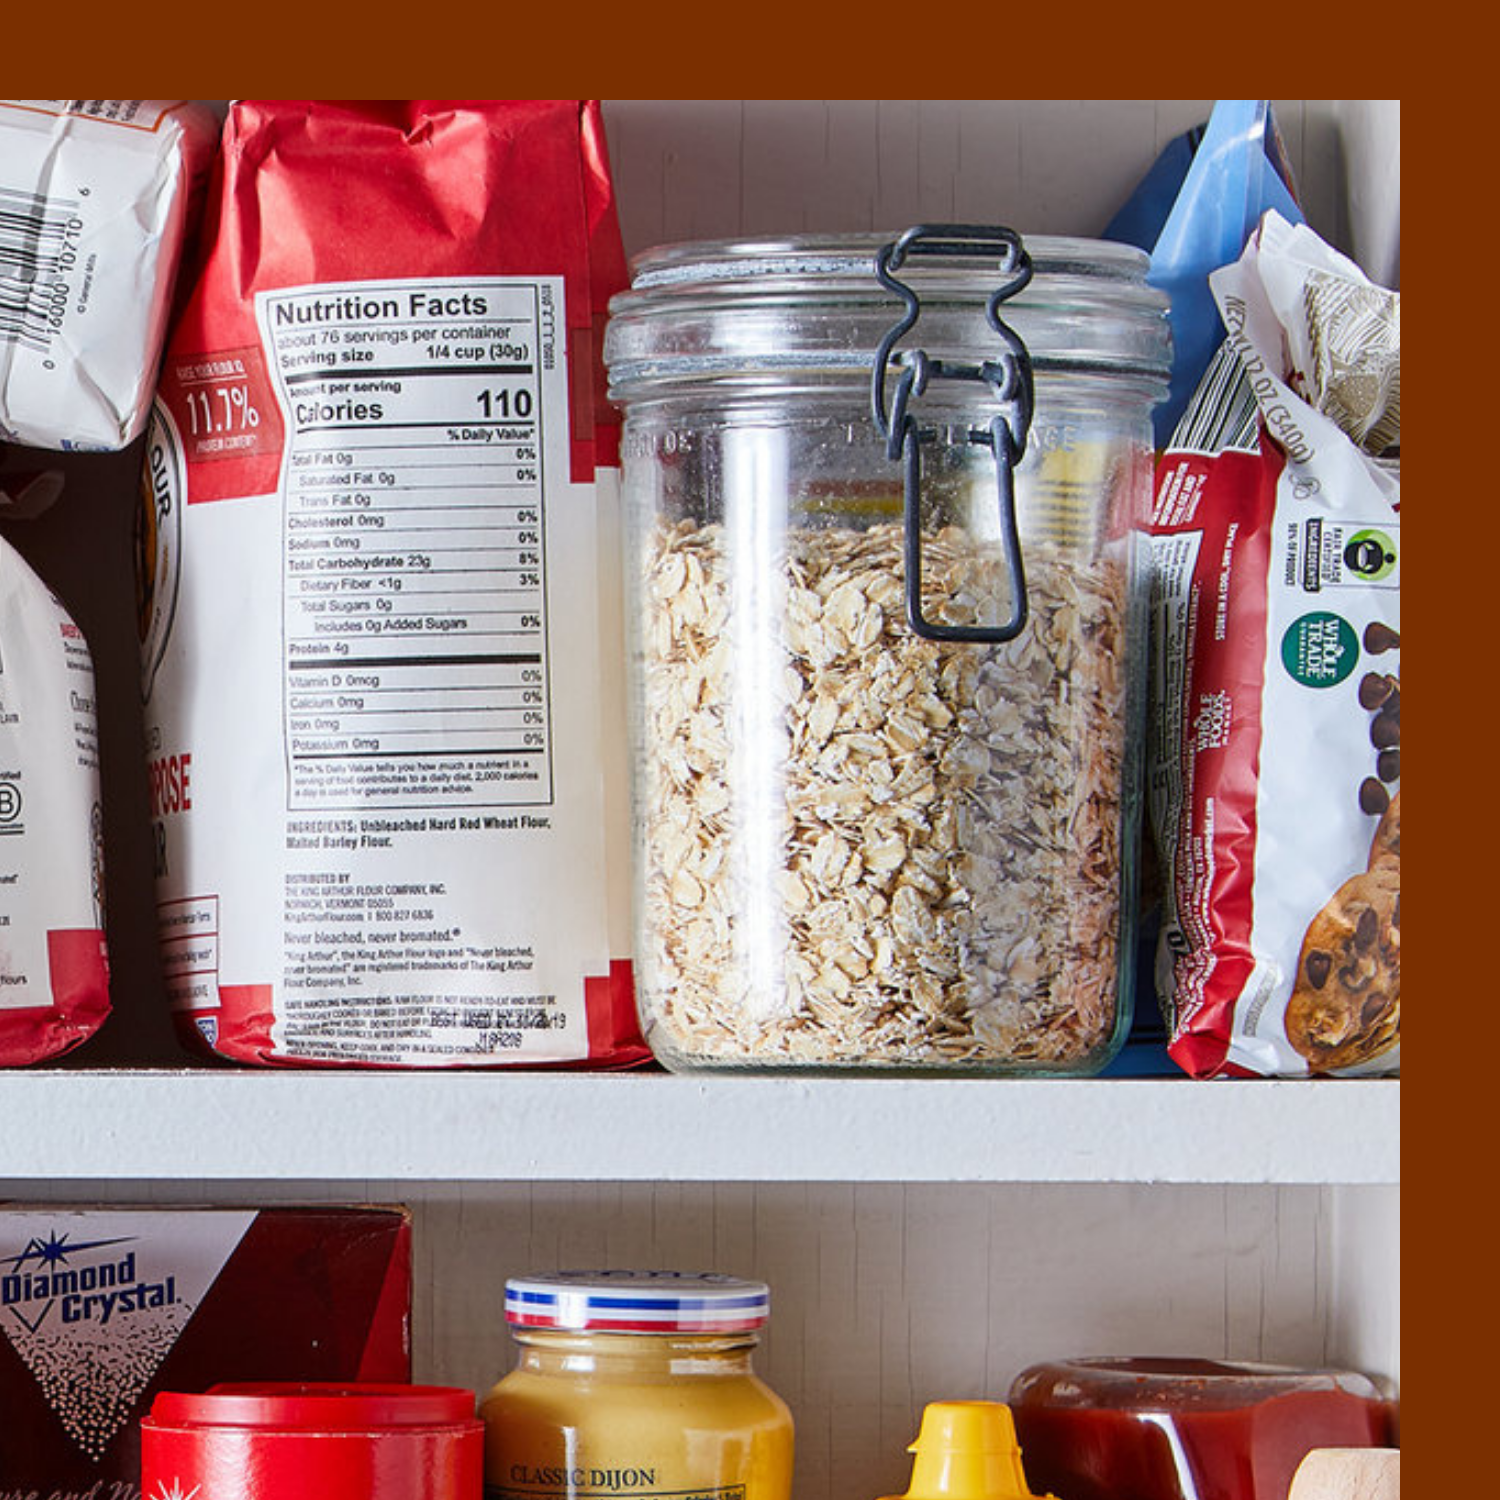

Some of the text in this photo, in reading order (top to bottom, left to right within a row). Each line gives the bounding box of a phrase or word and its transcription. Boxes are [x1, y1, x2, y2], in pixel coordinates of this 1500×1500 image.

[276, 293, 488, 325] Nutrition Facts
[344, 327, 408, 344] servings
[412, 329, 438, 343] per
[442, 326, 511, 340] container
[281, 349, 343, 368] Serving
[348, 348, 374, 361] size
[427, 345, 450, 358] 1/4
[455, 346, 485, 361] cup
[329, 381, 401, 396] per serving
[187, 385, 259, 434] 11.7%
[477, 389, 532, 417] 110
[462, 429, 492, 441] Daily
[354, 473, 373, 484] Fat
[317, 556, 404, 570] Carbohydrate
[384, 617, 422, 630] Added
[425, 616, 468, 630] Sugars
[1306, 619, 1323, 678] TRADE
[1323, 619, 1340, 678] WHOLE
[2, 1252, 136, 1307] Diamond
[511, 1464, 656, 1490] CLASSIC DIJON
